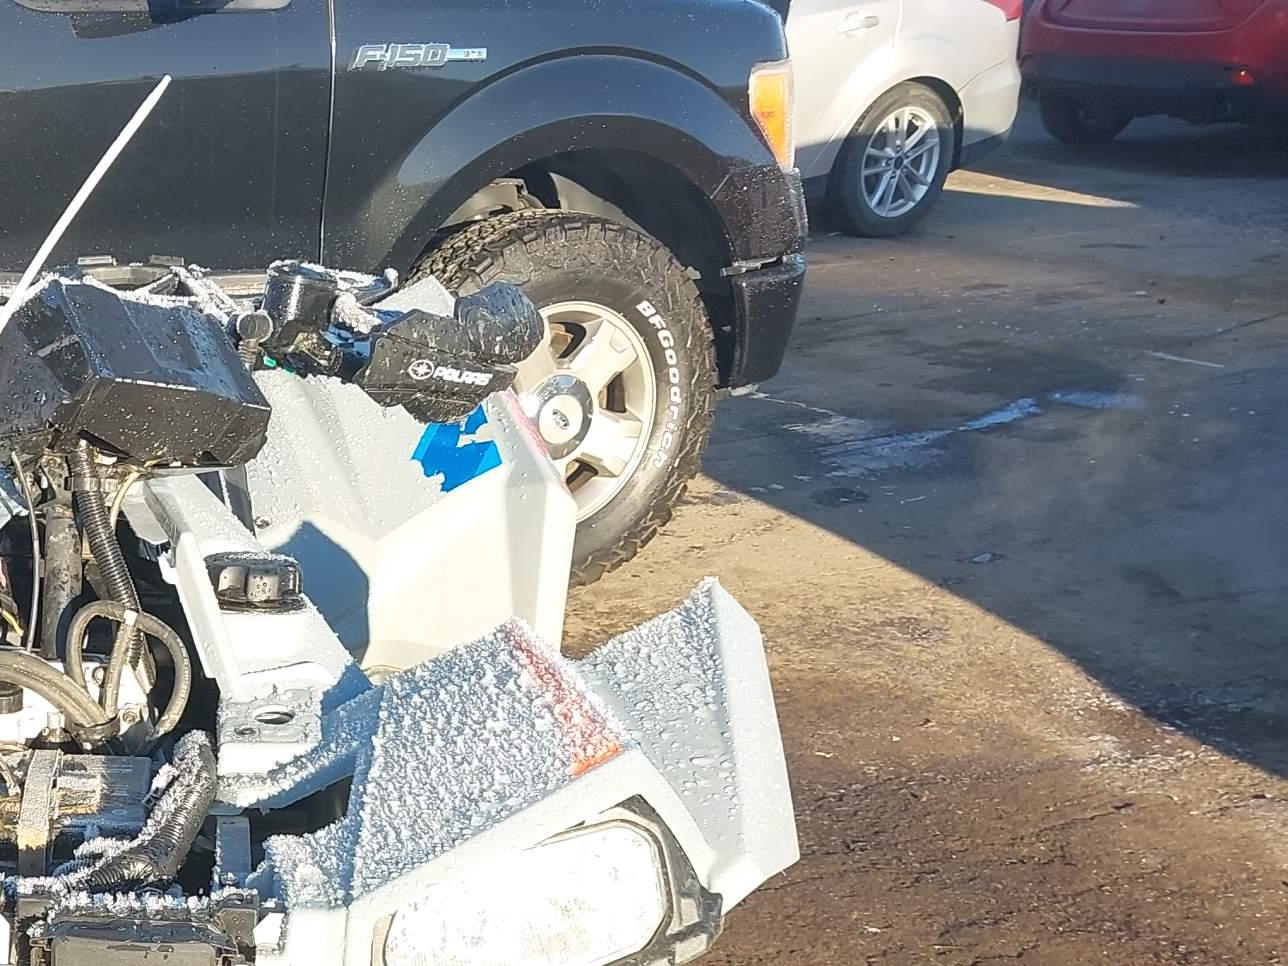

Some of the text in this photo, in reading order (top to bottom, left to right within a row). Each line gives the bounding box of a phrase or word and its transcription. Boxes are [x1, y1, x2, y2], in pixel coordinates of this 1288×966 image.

[348, 43, 450, 71] F-150
[433, 366, 494, 386] POLARIS
[636, 300, 682, 469] BFGoodrich
